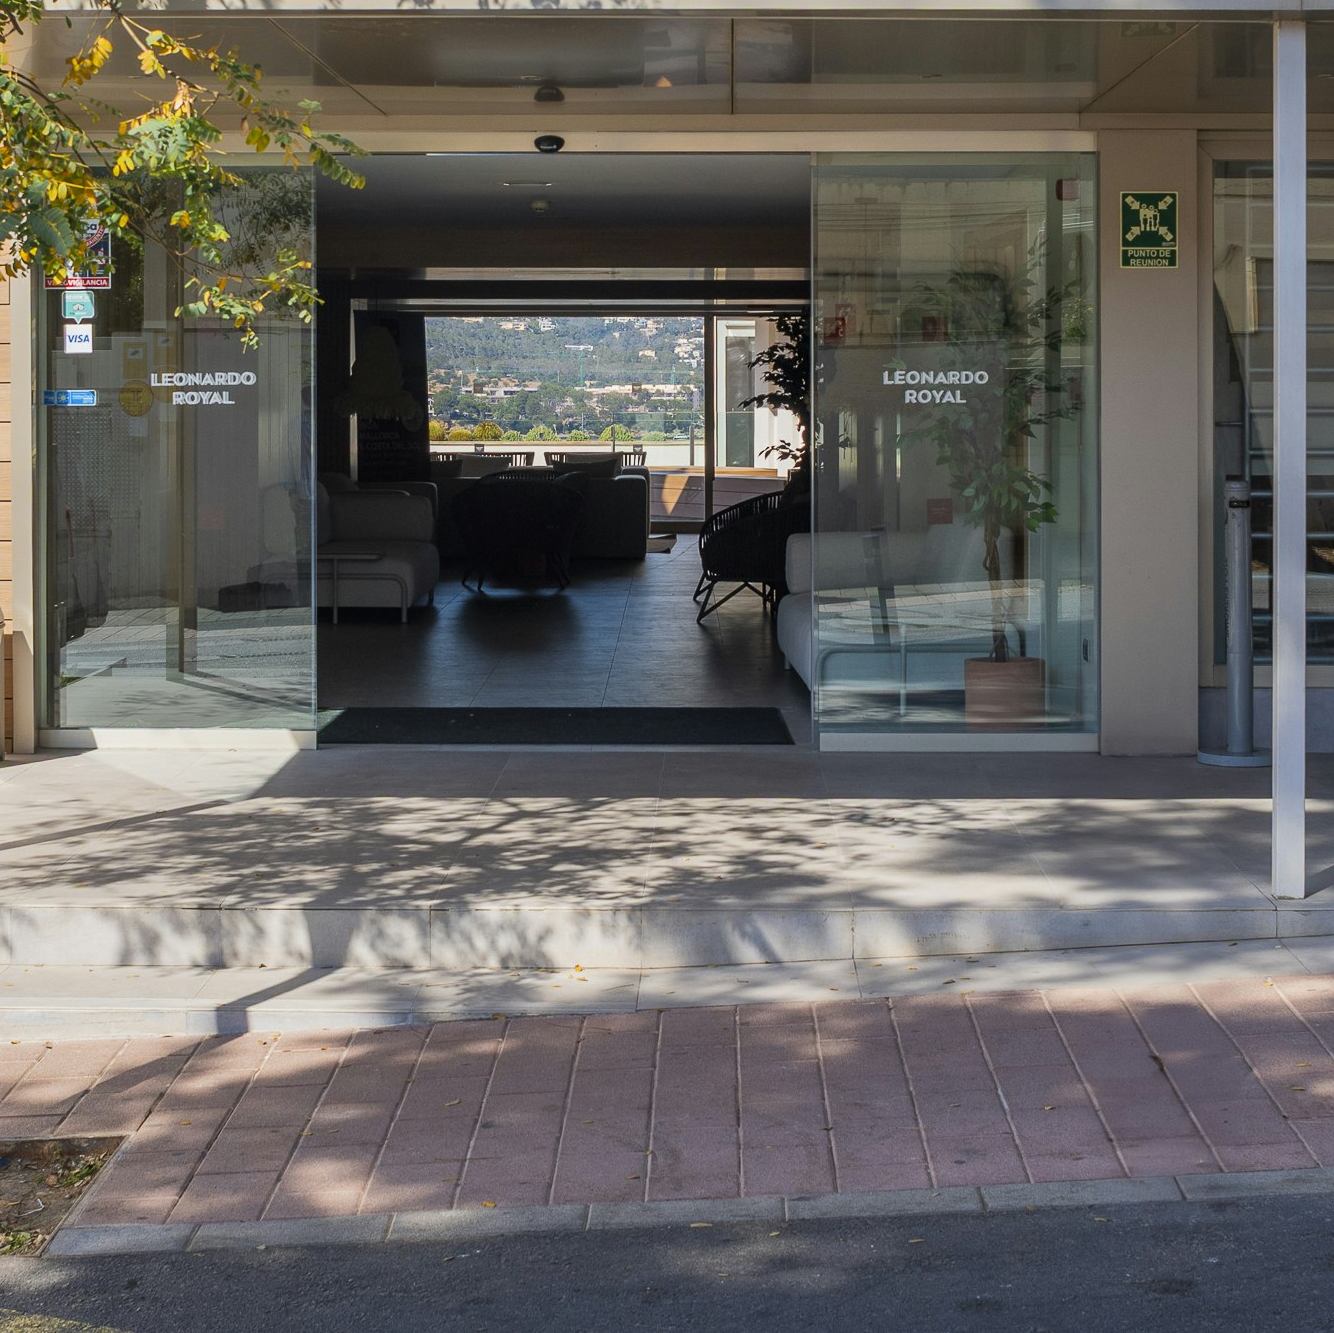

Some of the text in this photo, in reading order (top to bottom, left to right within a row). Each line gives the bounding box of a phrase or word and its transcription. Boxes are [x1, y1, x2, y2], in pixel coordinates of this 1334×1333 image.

[1127, 249, 1171, 258] PUNTO DE
[1130, 258, 1169, 267] REUNION
[47, 278, 108, 287] VOVIGILANCIA
[67, 334, 90, 343] VISA
[150, 371, 257, 387] LEONARDO
[882, 370, 989, 385] LEONARDO
[172, 391, 235, 406] ROYAL
[904, 389, 967, 404] ROYAL
